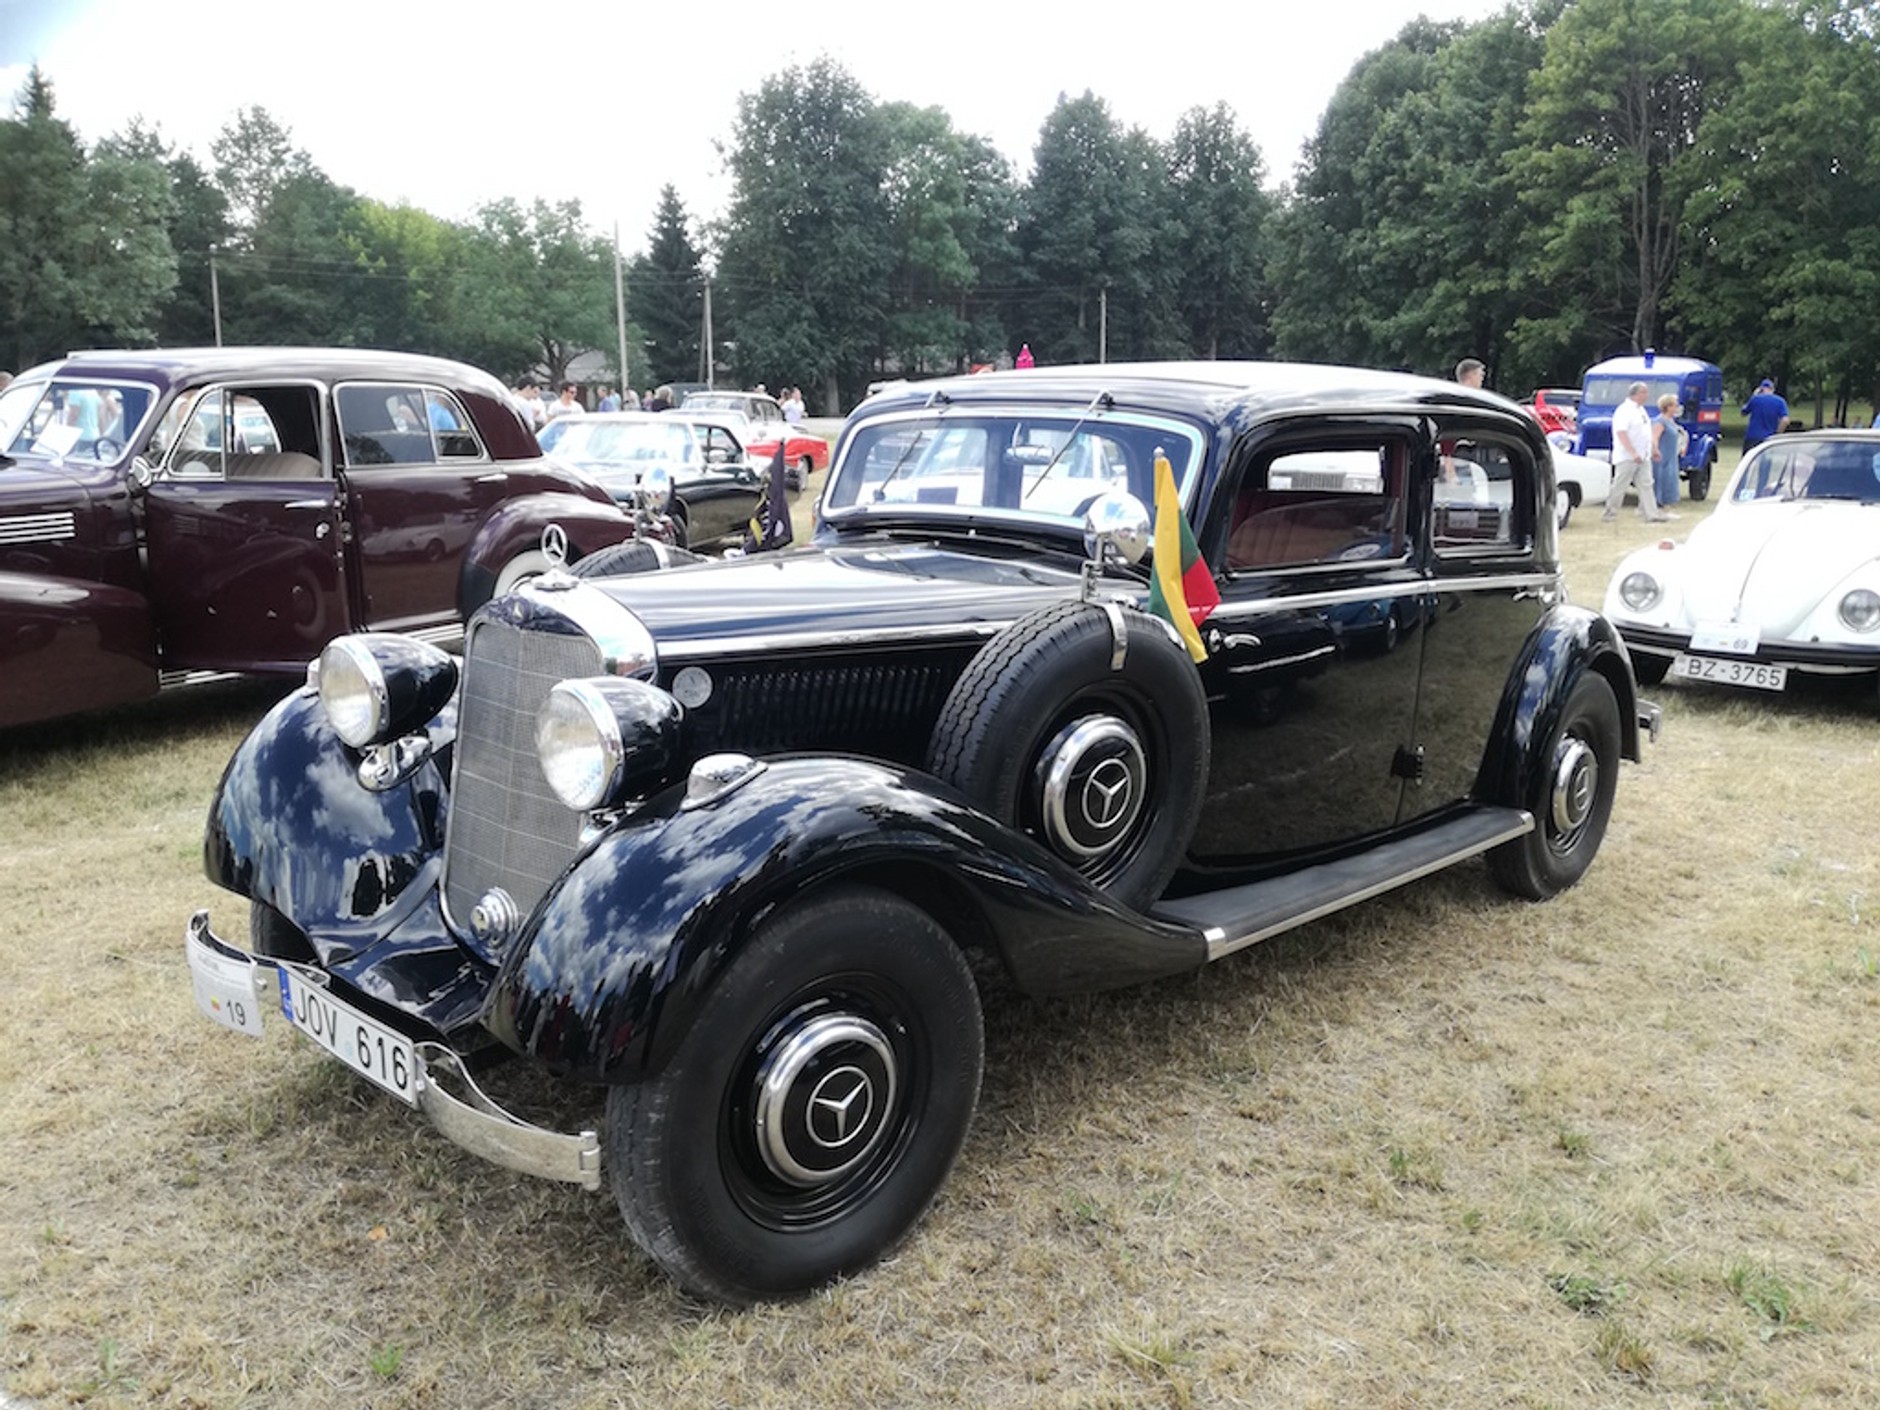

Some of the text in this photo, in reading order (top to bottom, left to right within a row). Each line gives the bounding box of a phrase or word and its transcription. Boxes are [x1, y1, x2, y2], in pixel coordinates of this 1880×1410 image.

[1688, 659, 1782, 687] BZ-3765
[227, 999, 246, 1026] 19
[295, 988, 407, 1091] JOV 616
